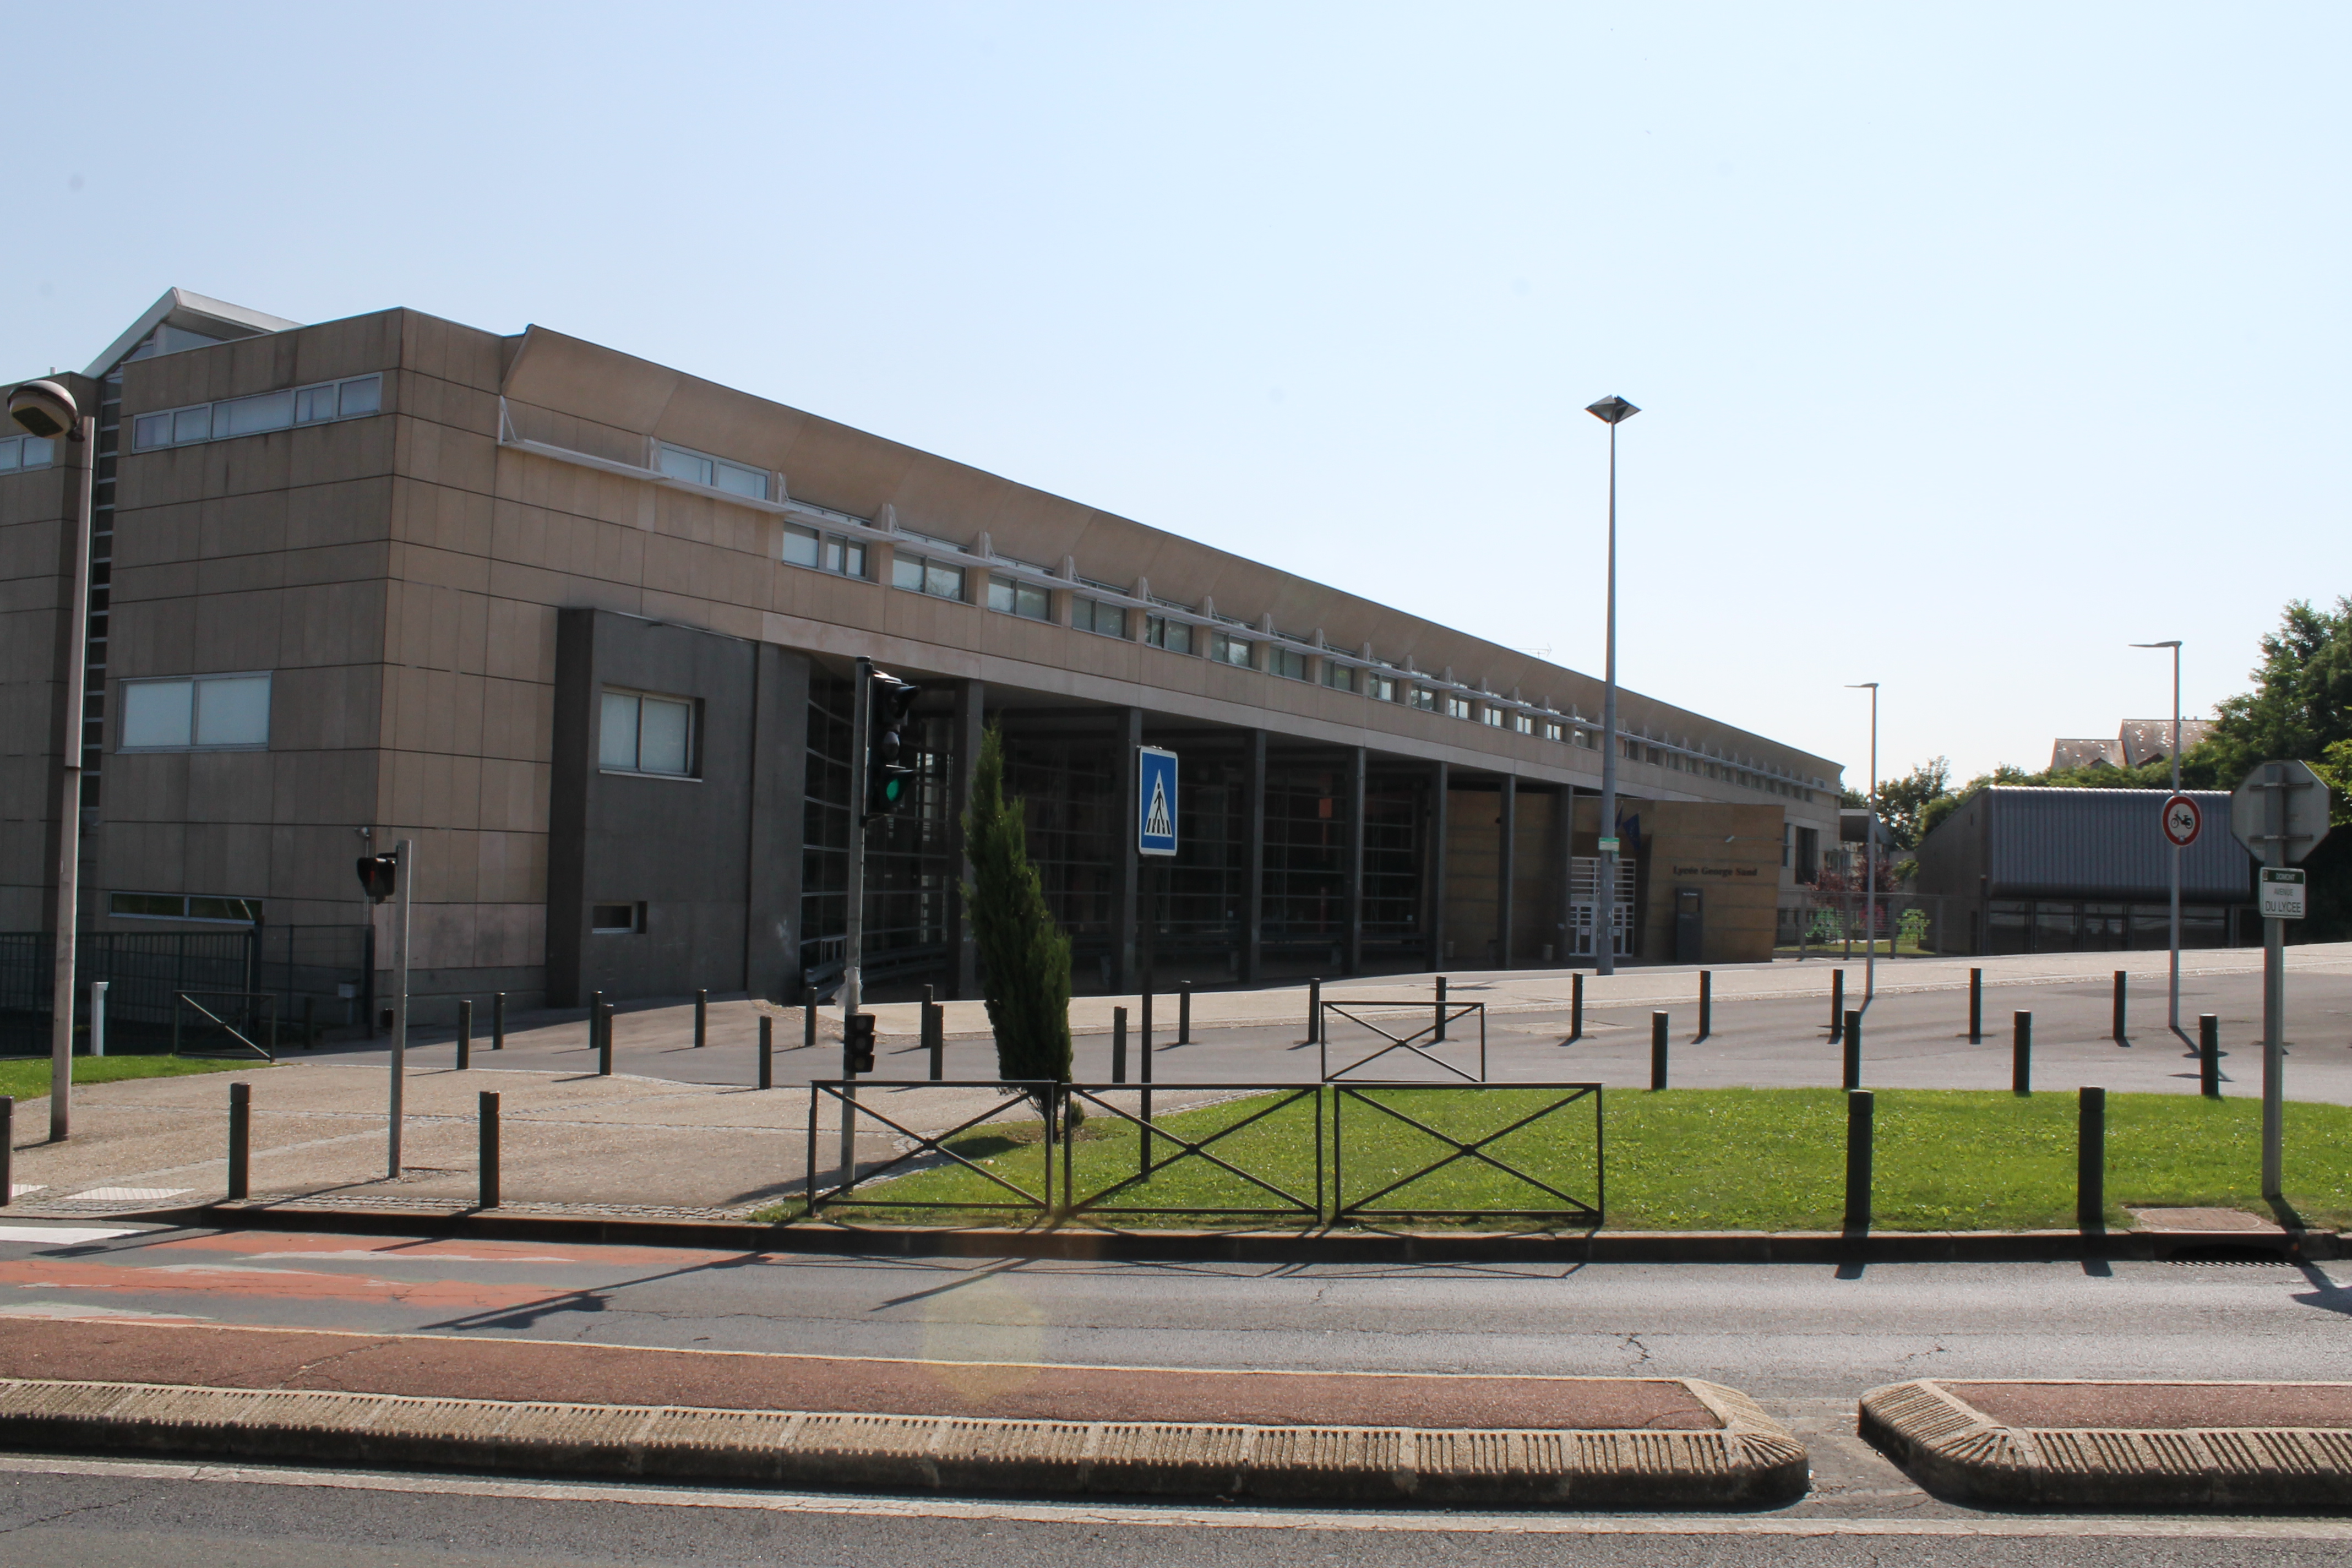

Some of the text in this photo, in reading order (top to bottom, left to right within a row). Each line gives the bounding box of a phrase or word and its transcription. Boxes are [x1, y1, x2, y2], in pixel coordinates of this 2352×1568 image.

[1674, 865, 1757, 878] Lycée George Sand
[2266, 901, 2301, 913] DU LYCEE
